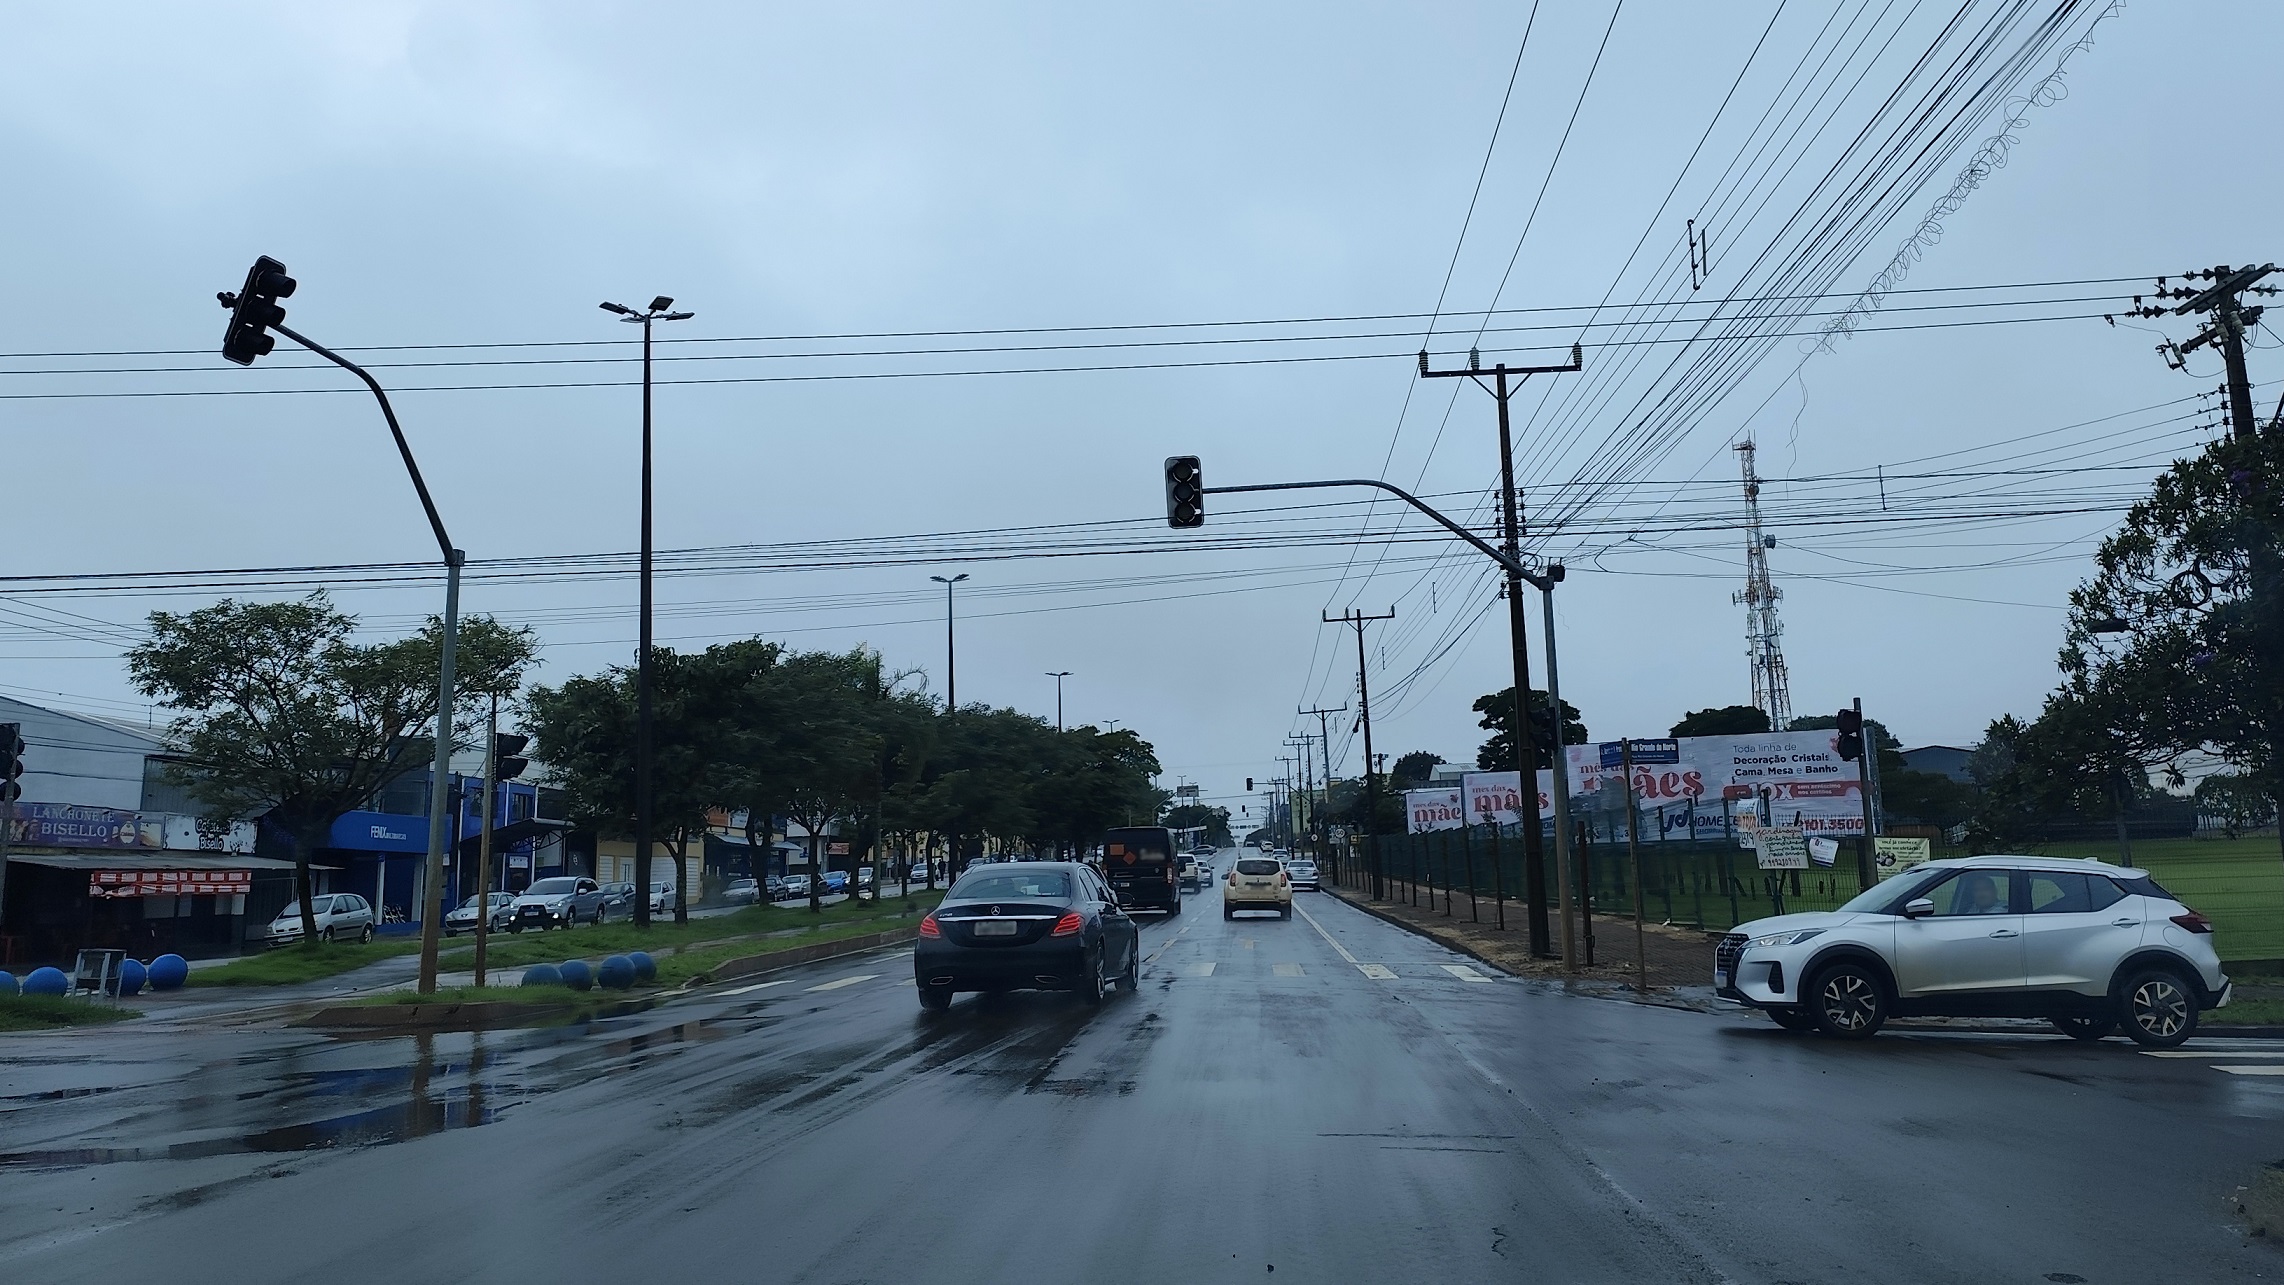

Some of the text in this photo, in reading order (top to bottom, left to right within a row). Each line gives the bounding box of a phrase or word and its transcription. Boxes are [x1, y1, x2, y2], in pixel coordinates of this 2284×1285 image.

[1639, 743, 1655, 751] Grande
[1733, 742, 1797, 753] Toda linha de
[1733, 754, 1787, 765] Decoração
[1767, 766, 1794, 775] Mesa
[1805, 765, 1839, 774] Banho
[33, 806, 115, 823] LANCHONETE
[41, 822, 107, 838] BISELLO
[200, 837, 224, 850] Bisello
